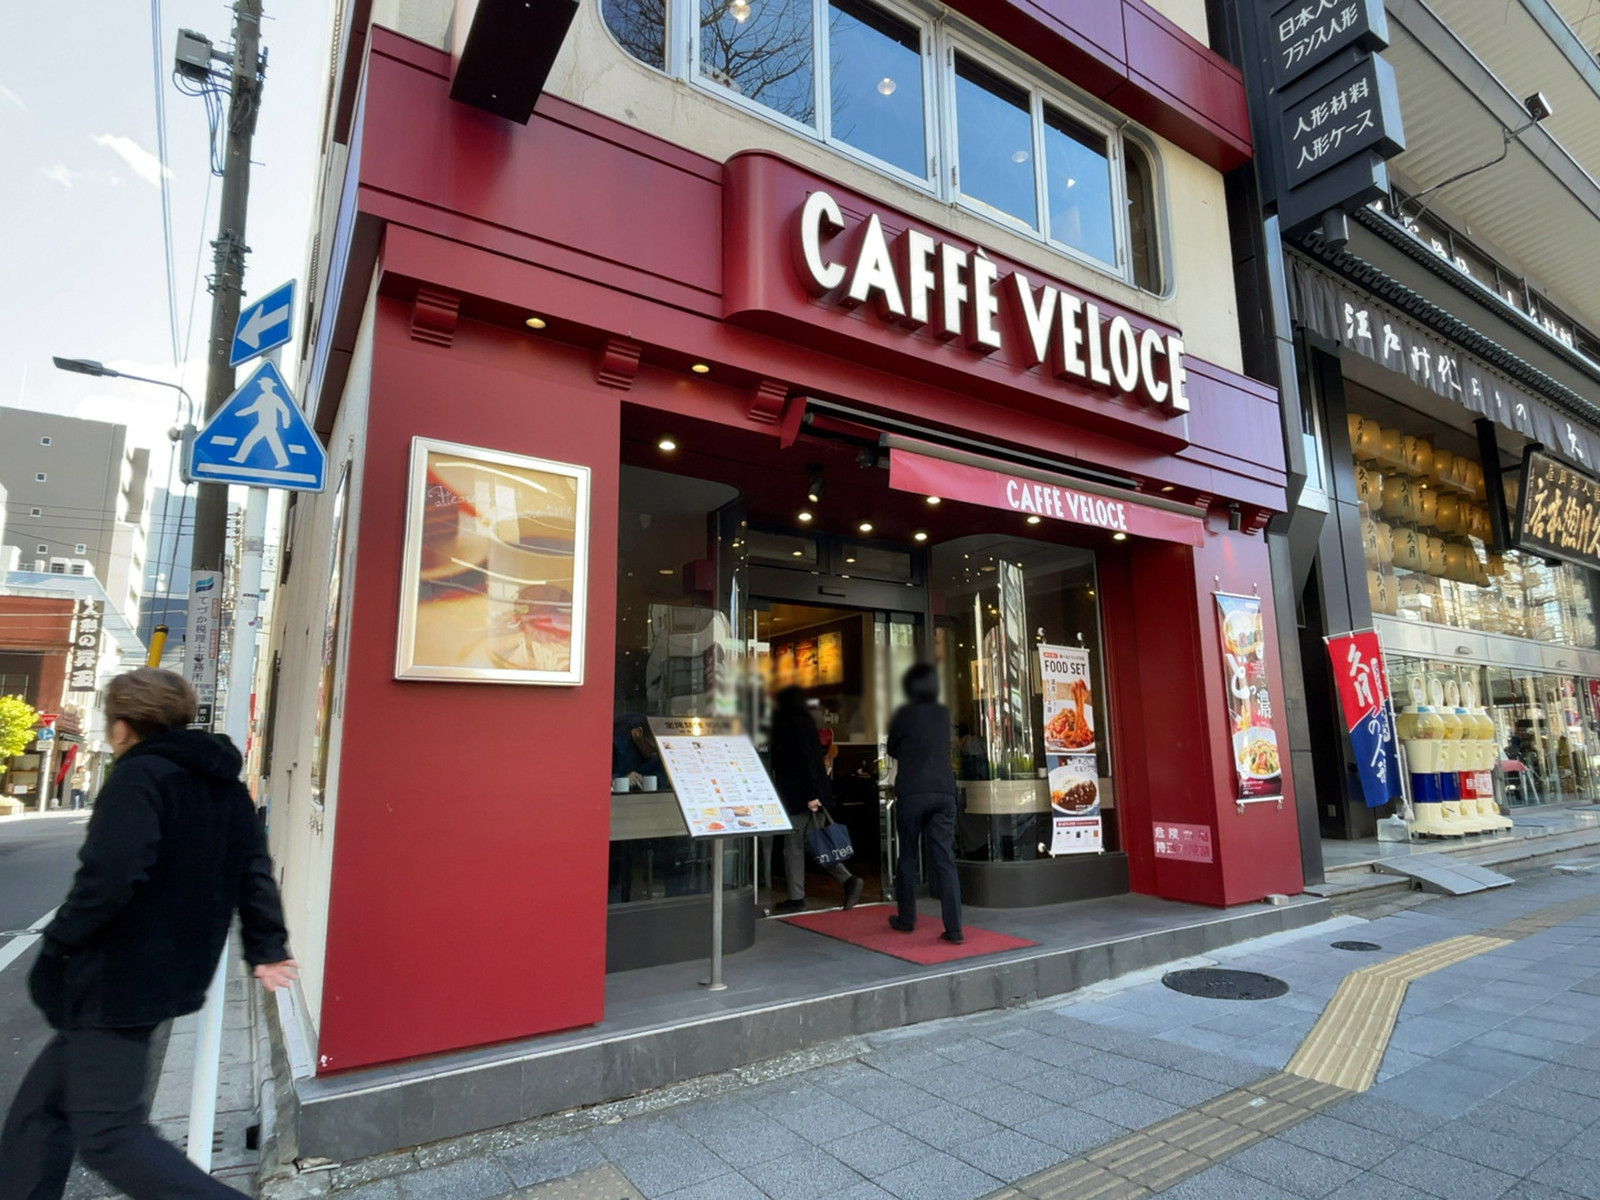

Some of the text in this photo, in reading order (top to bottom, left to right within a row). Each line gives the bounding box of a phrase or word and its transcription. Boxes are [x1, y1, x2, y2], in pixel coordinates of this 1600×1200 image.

[1279, 0, 1338, 42] 日本人
[1282, 3, 1358, 69] フランス人形
[1293, 77, 1369, 140] 人形材料
[1297, 109, 1374, 169] 人形ケース
[801, 190, 1191, 413] CAFFÈ VELOCE
[1006, 479, 1127, 530] CAFFÈ VELOCE
[1358, 468, 1369, 495] 久月
[1407, 531, 1416, 559] 久月
[1044, 659, 1086, 675] FOOD SET
[831, 845, 854, 860] Tea
